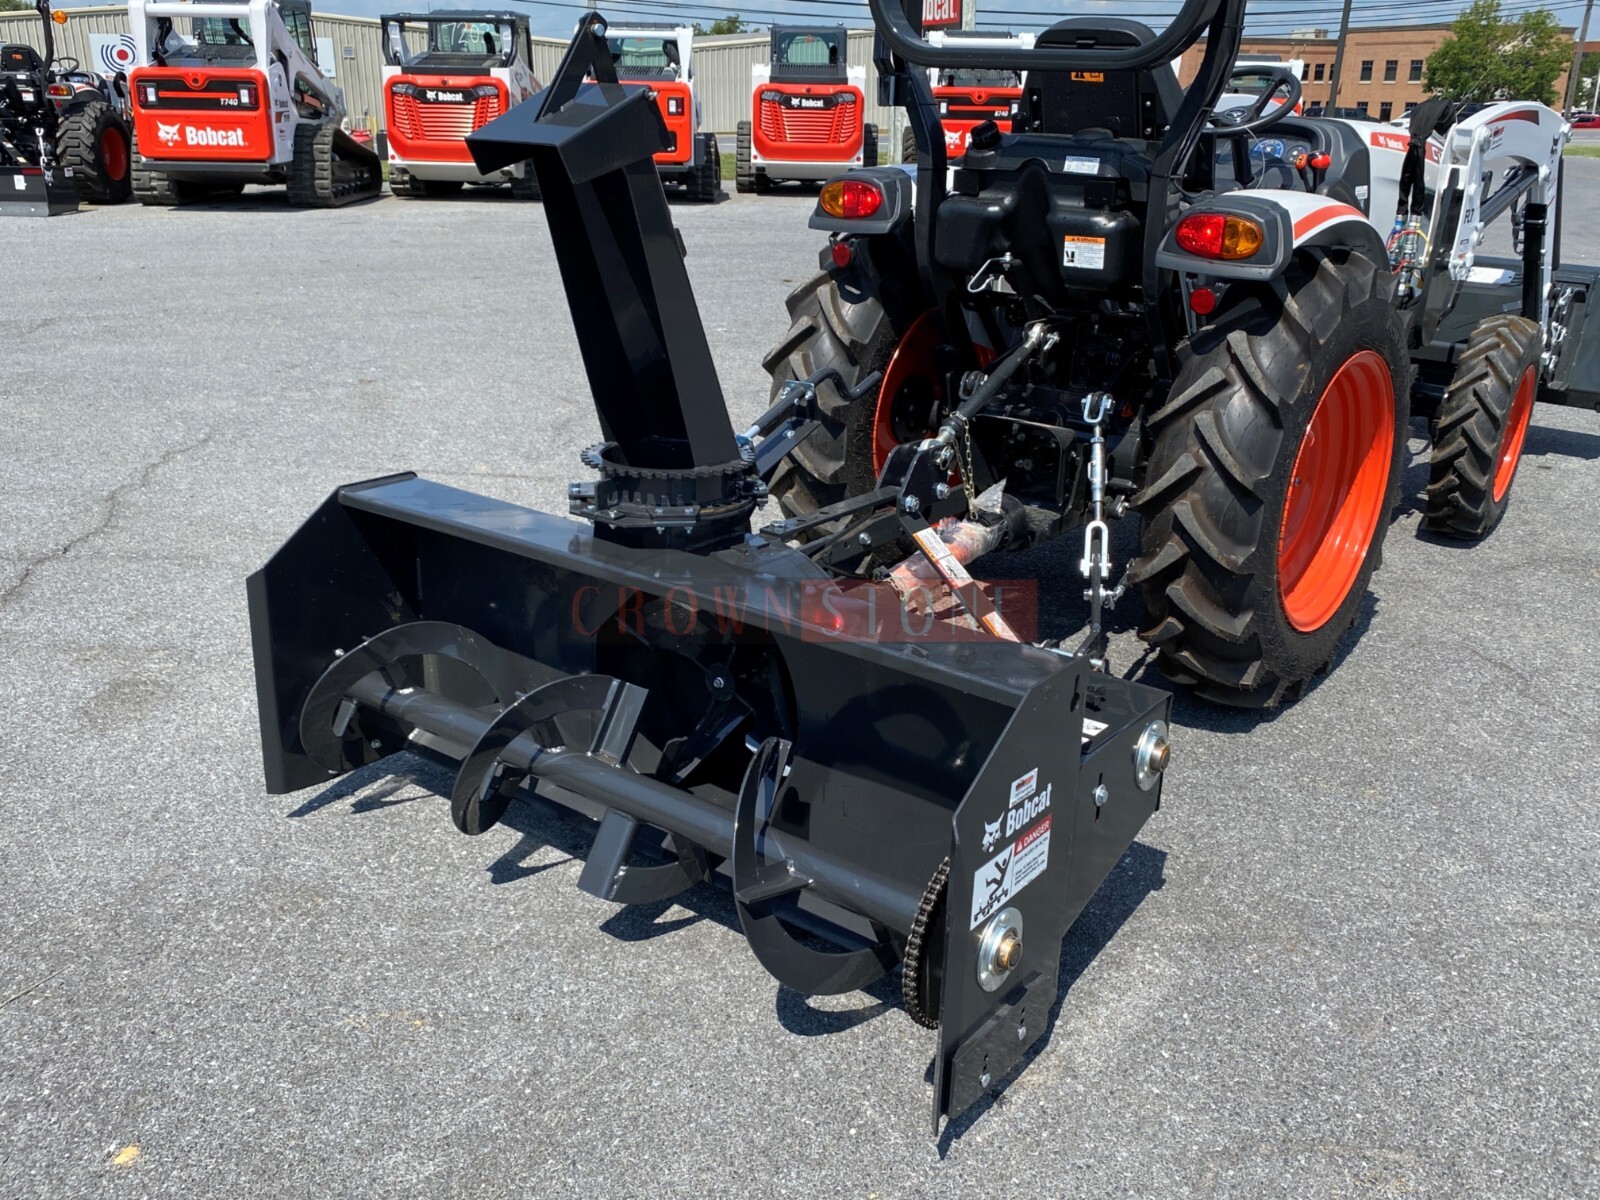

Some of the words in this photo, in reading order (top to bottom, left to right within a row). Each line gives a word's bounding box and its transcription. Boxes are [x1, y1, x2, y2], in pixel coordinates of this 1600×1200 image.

[922, 0, 954, 21] bcat
[438, 91, 464, 101] Bobcat
[802, 98, 824, 107] Bobcat
[185, 126, 244, 146] Bobcat
[1006, 782, 1052, 838] Bobcat
[1023, 820, 1050, 847] DANGER
